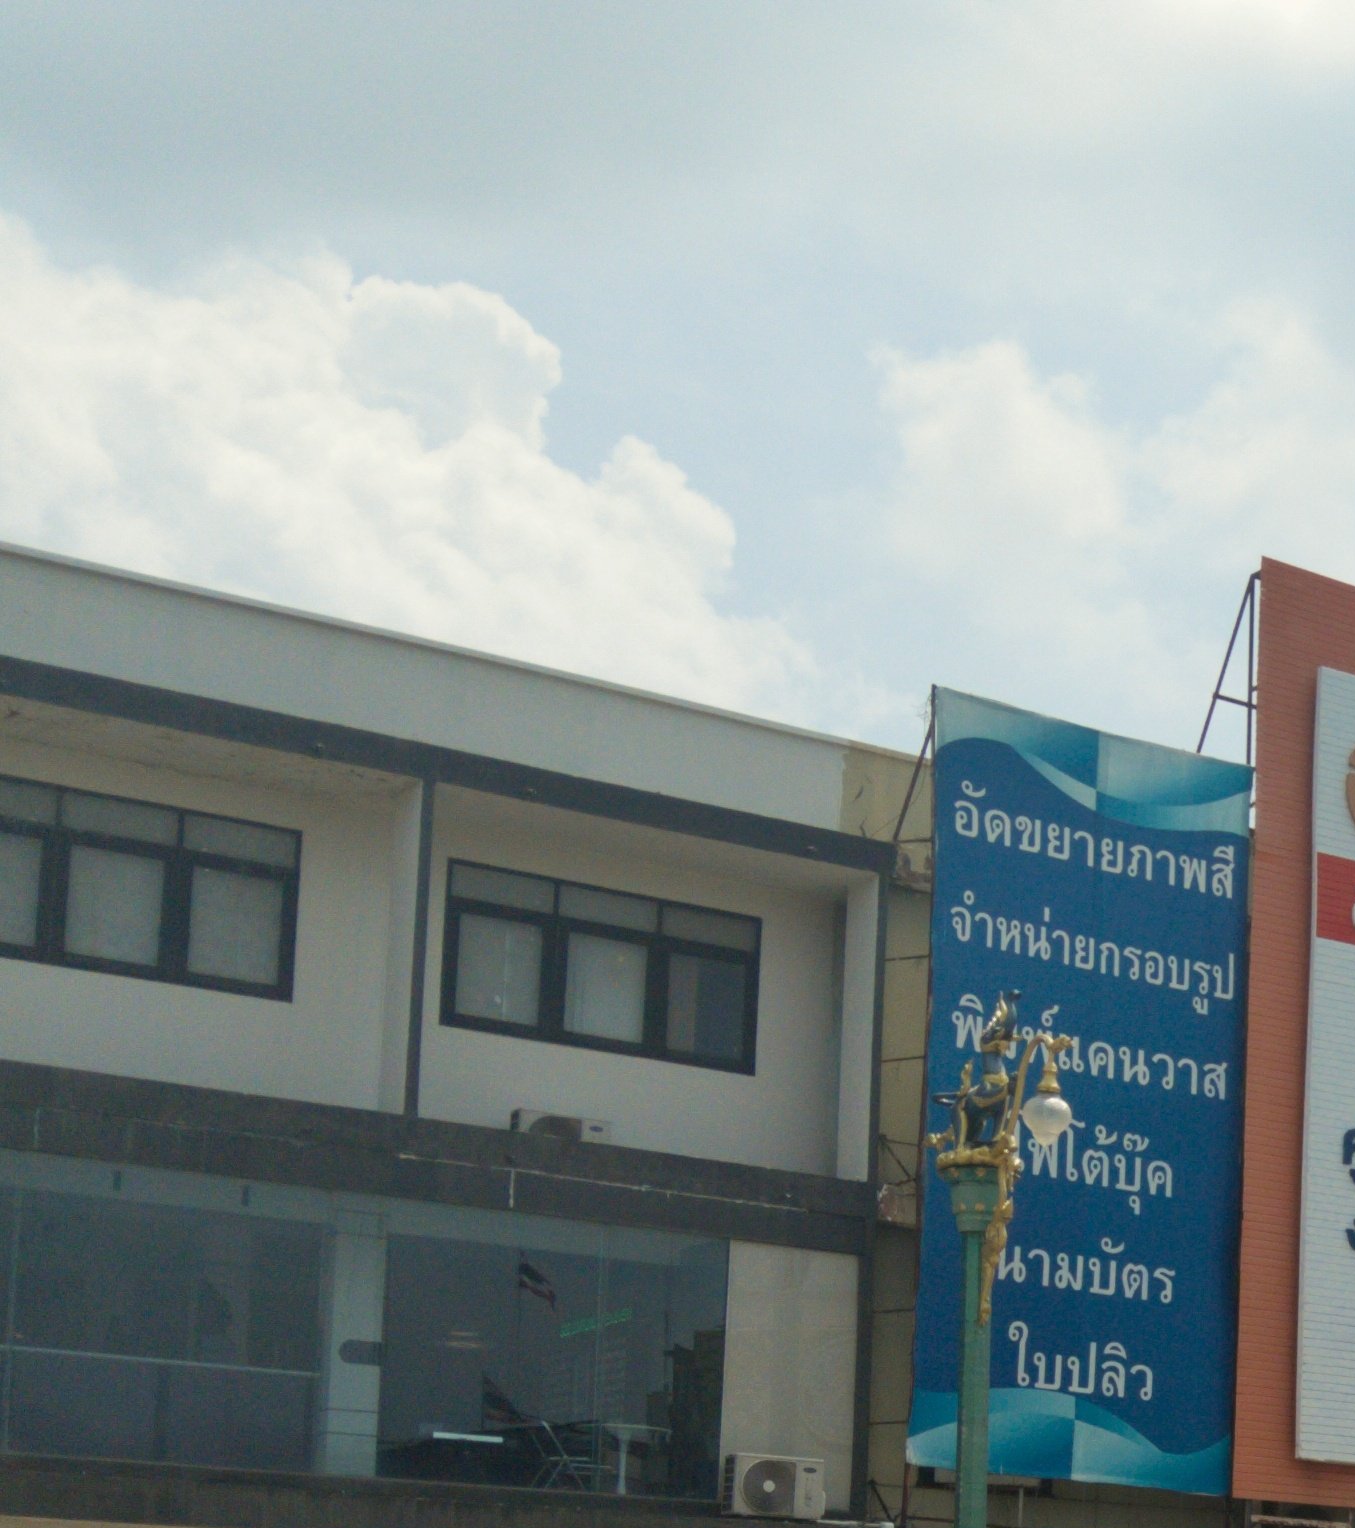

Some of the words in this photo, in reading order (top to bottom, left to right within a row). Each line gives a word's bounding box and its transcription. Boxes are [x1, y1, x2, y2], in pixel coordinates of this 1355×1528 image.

[954, 780, 1236, 900] อัดขยายภาพสี
[950, 889, 1236, 1016] จำหน่ายกรอบรูป
[998, 1237, 1177, 1304] นามบัตร
[1008, 1320, 1154, 1401] ใบปลิว
